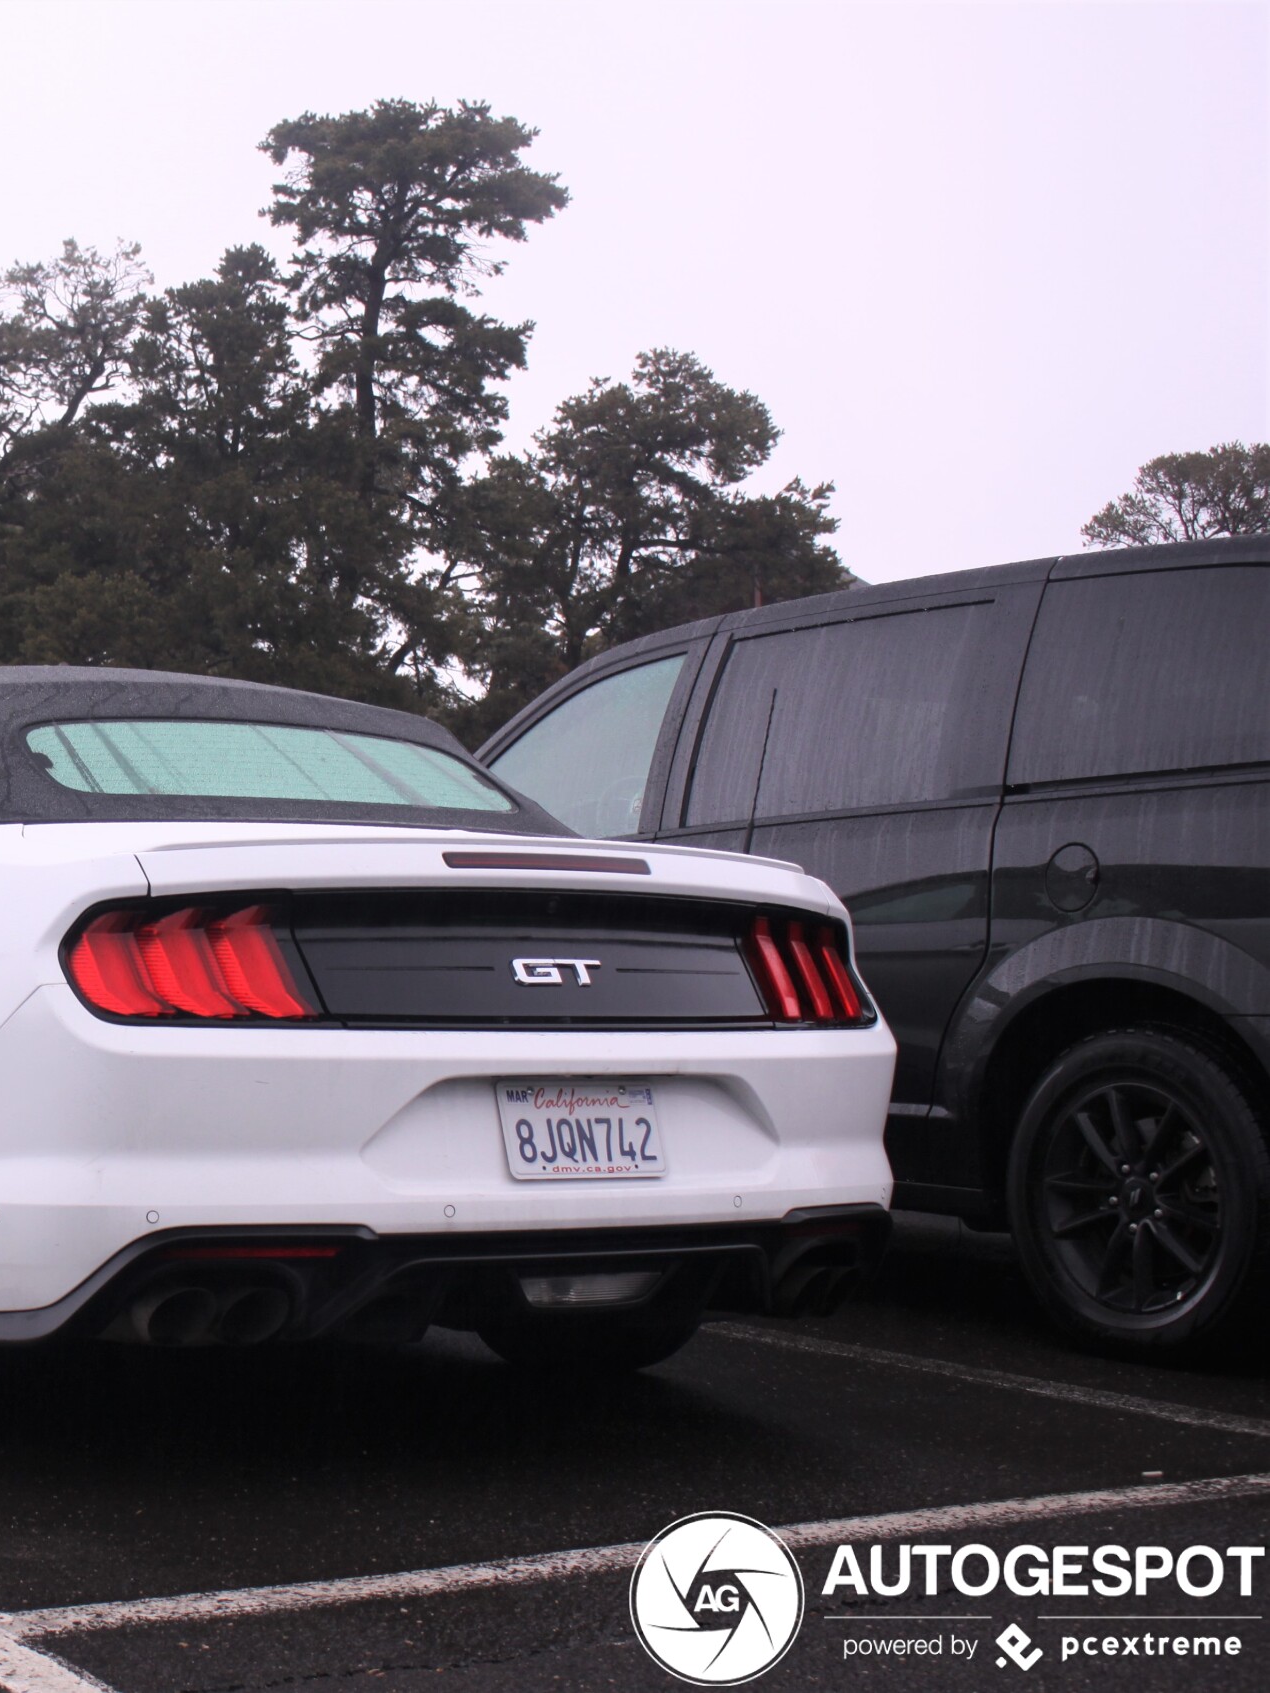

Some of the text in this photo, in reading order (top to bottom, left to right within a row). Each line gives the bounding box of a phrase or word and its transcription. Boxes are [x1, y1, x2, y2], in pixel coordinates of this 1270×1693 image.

[512, 958, 602, 987] GT
[506, 1089, 529, 1104] MAR
[533, 1087, 630, 1116] California
[515, 1117, 658, 1164] 8JQN742
[552, 1164, 632, 1174] dmv.ca.gov
